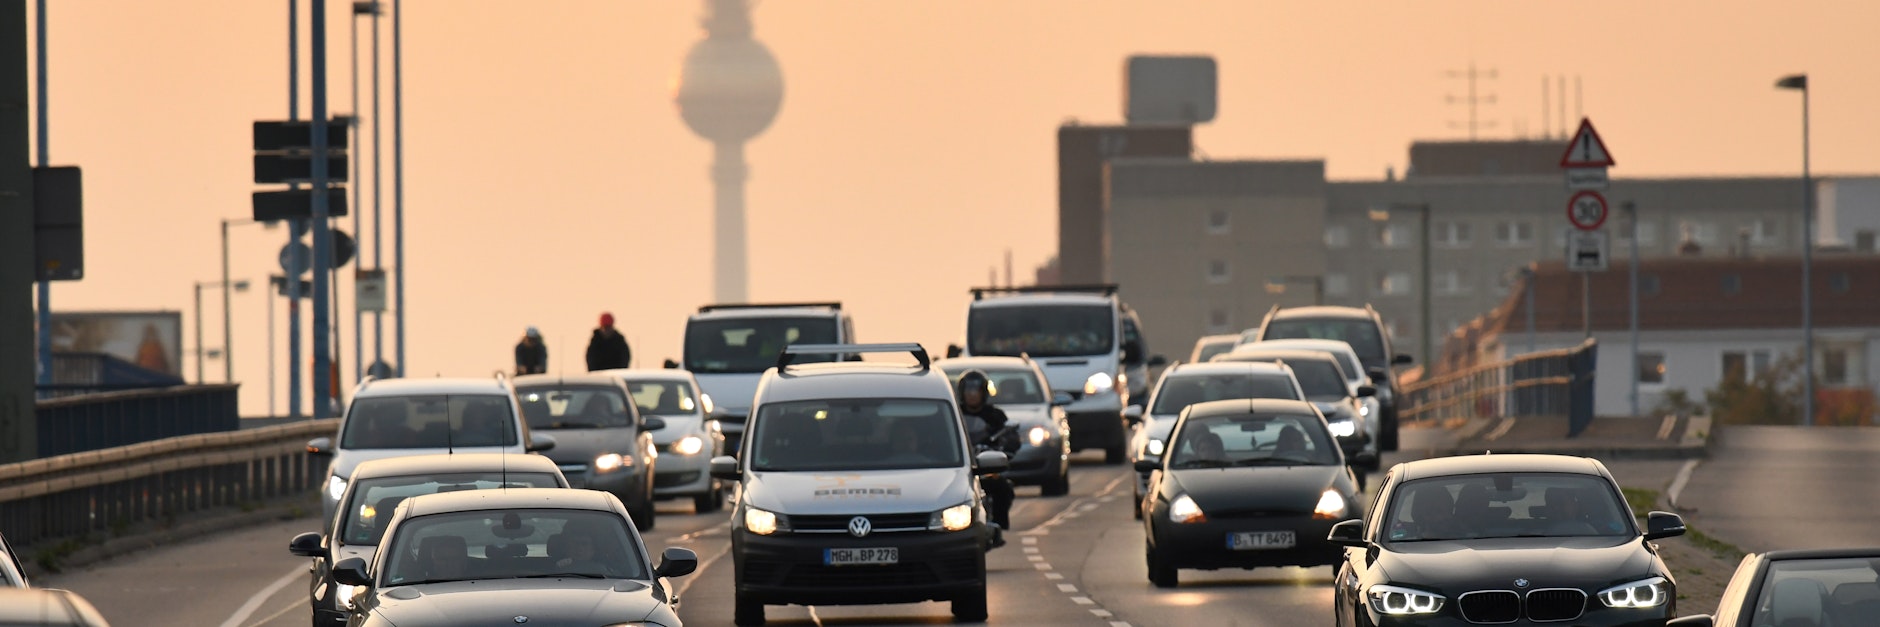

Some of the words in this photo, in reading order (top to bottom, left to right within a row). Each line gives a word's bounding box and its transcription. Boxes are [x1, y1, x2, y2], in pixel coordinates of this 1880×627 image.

[1576, 201, 1602, 221] 30
[849, 516, 871, 537] VW
[1235, 535, 1241, 545] B
[1250, 534, 1264, 544] TT
[1266, 533, 1292, 544] 8491
[831, 550, 853, 562] MGH
[860, 549, 875, 561] BP
[877, 549, 898, 561] 278
